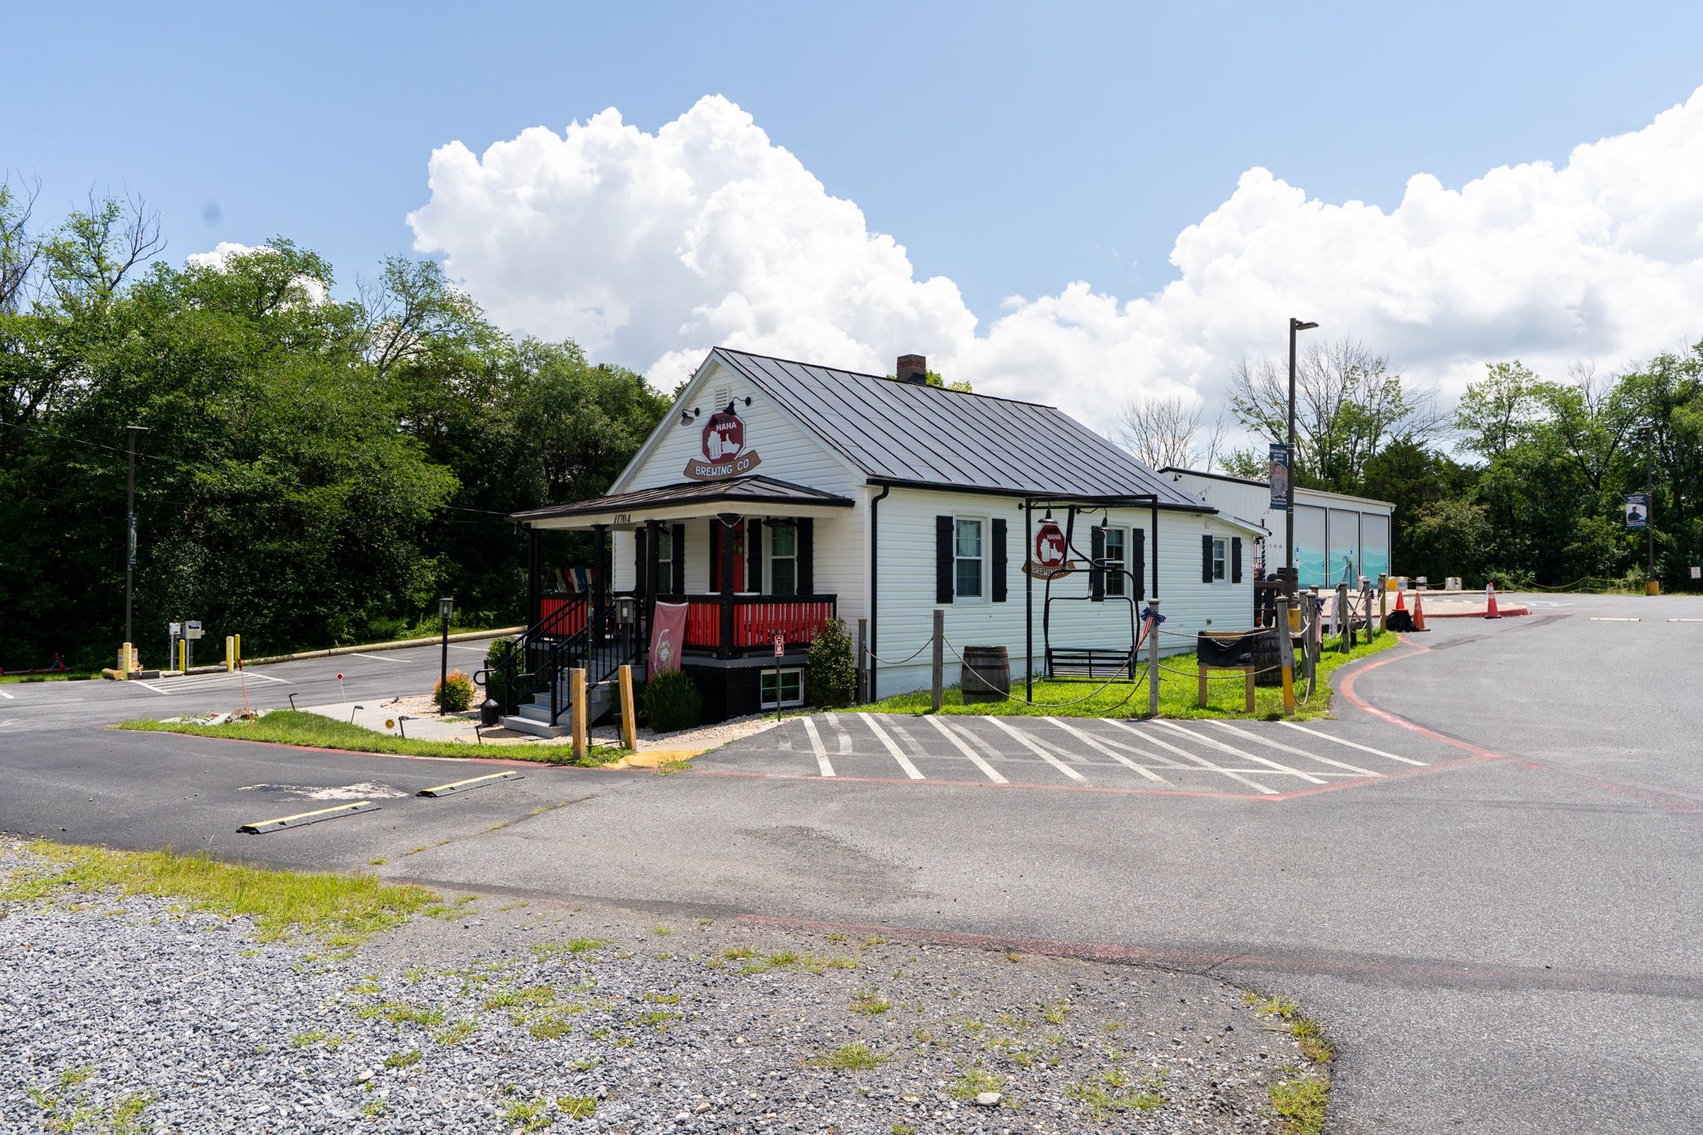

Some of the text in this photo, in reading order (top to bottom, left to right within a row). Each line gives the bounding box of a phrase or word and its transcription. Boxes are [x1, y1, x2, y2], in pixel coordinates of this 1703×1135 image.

[716, 422, 737, 431] HAHA
[695, 458, 750, 476] BREWING CO
